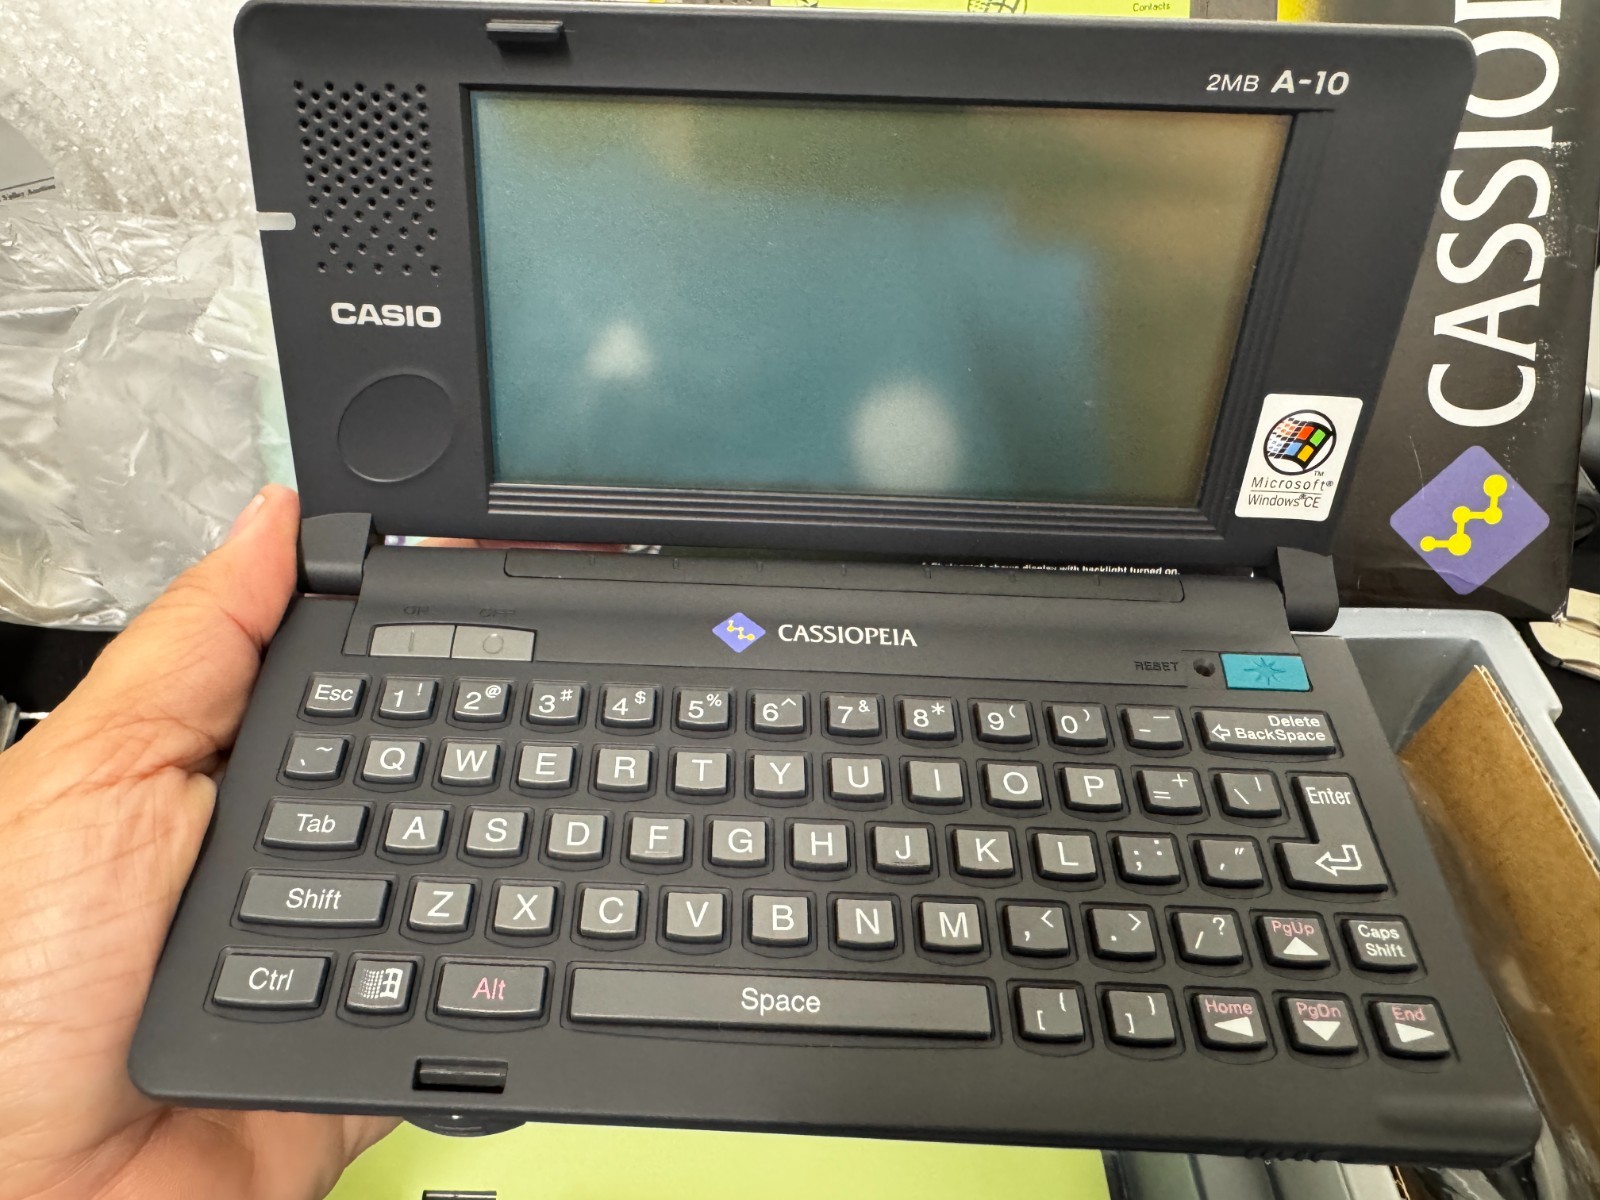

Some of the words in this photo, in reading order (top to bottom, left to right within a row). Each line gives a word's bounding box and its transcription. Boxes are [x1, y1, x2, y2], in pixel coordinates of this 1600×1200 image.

[1132, 2, 1171, 12] Contacts
[1206, 74, 1259, 92] 2MB
[1271, 70, 1350, 96] A-10
[1427, 0, 1561, 427] CASSIO
[331, 302, 442, 328] CASIO
[1303, 496, 1322, 509] CE
[778, 624, 918, 647] CASSIOPEIA
[1134, 660, 1179, 672] RESET
[314, 684, 354, 701] Esc
[1267, 715, 1320, 727] Delete
[1235, 728, 1326, 743] BackSpace
[380, 747, 405, 770] Q
[456, 749, 487, 772] W
[535, 752, 558, 775] E
[614, 756, 636, 779] R
[691, 759, 713, 782] T
[769, 762, 791, 785] Y
[848, 765, 869, 788] U
[934, 769, 941, 791] I
[1003, 771, 1029, 795] O
[1083, 775, 1104, 798] P
[1306, 786, 1351, 805] Enter
[297, 813, 336, 834] Tab
[402, 816, 426, 840] A
[485, 817, 508, 843] S
[566, 821, 590, 846] D
[648, 825, 669, 850] F
[728, 828, 753, 854] G
[810, 831, 833, 856] H
[895, 835, 911, 860] J
[975, 838, 1000, 863] K
[1057, 841, 1079, 866] L
[285, 887, 342, 910] Shift
[427, 890, 454, 918] Z
[512, 894, 539, 921] X
[599, 896, 624, 925] C
[685, 901, 710, 928] V
[772, 904, 795, 931] B
[855, 908, 880, 935] N
[939, 911, 970, 939] M
[1271, 920, 1315, 937] PgUp
[1357, 924, 1400, 941] Caps
[1365, 942, 1407, 958] Shift
[248, 967, 294, 992] Ctrl
[471, 977, 506, 1000] Alt
[740, 987, 821, 1014] Space
[1204, 999, 1253, 1016] Home
[1296, 1002, 1342, 1020] PgDn
[1391, 1006, 1426, 1022] End
